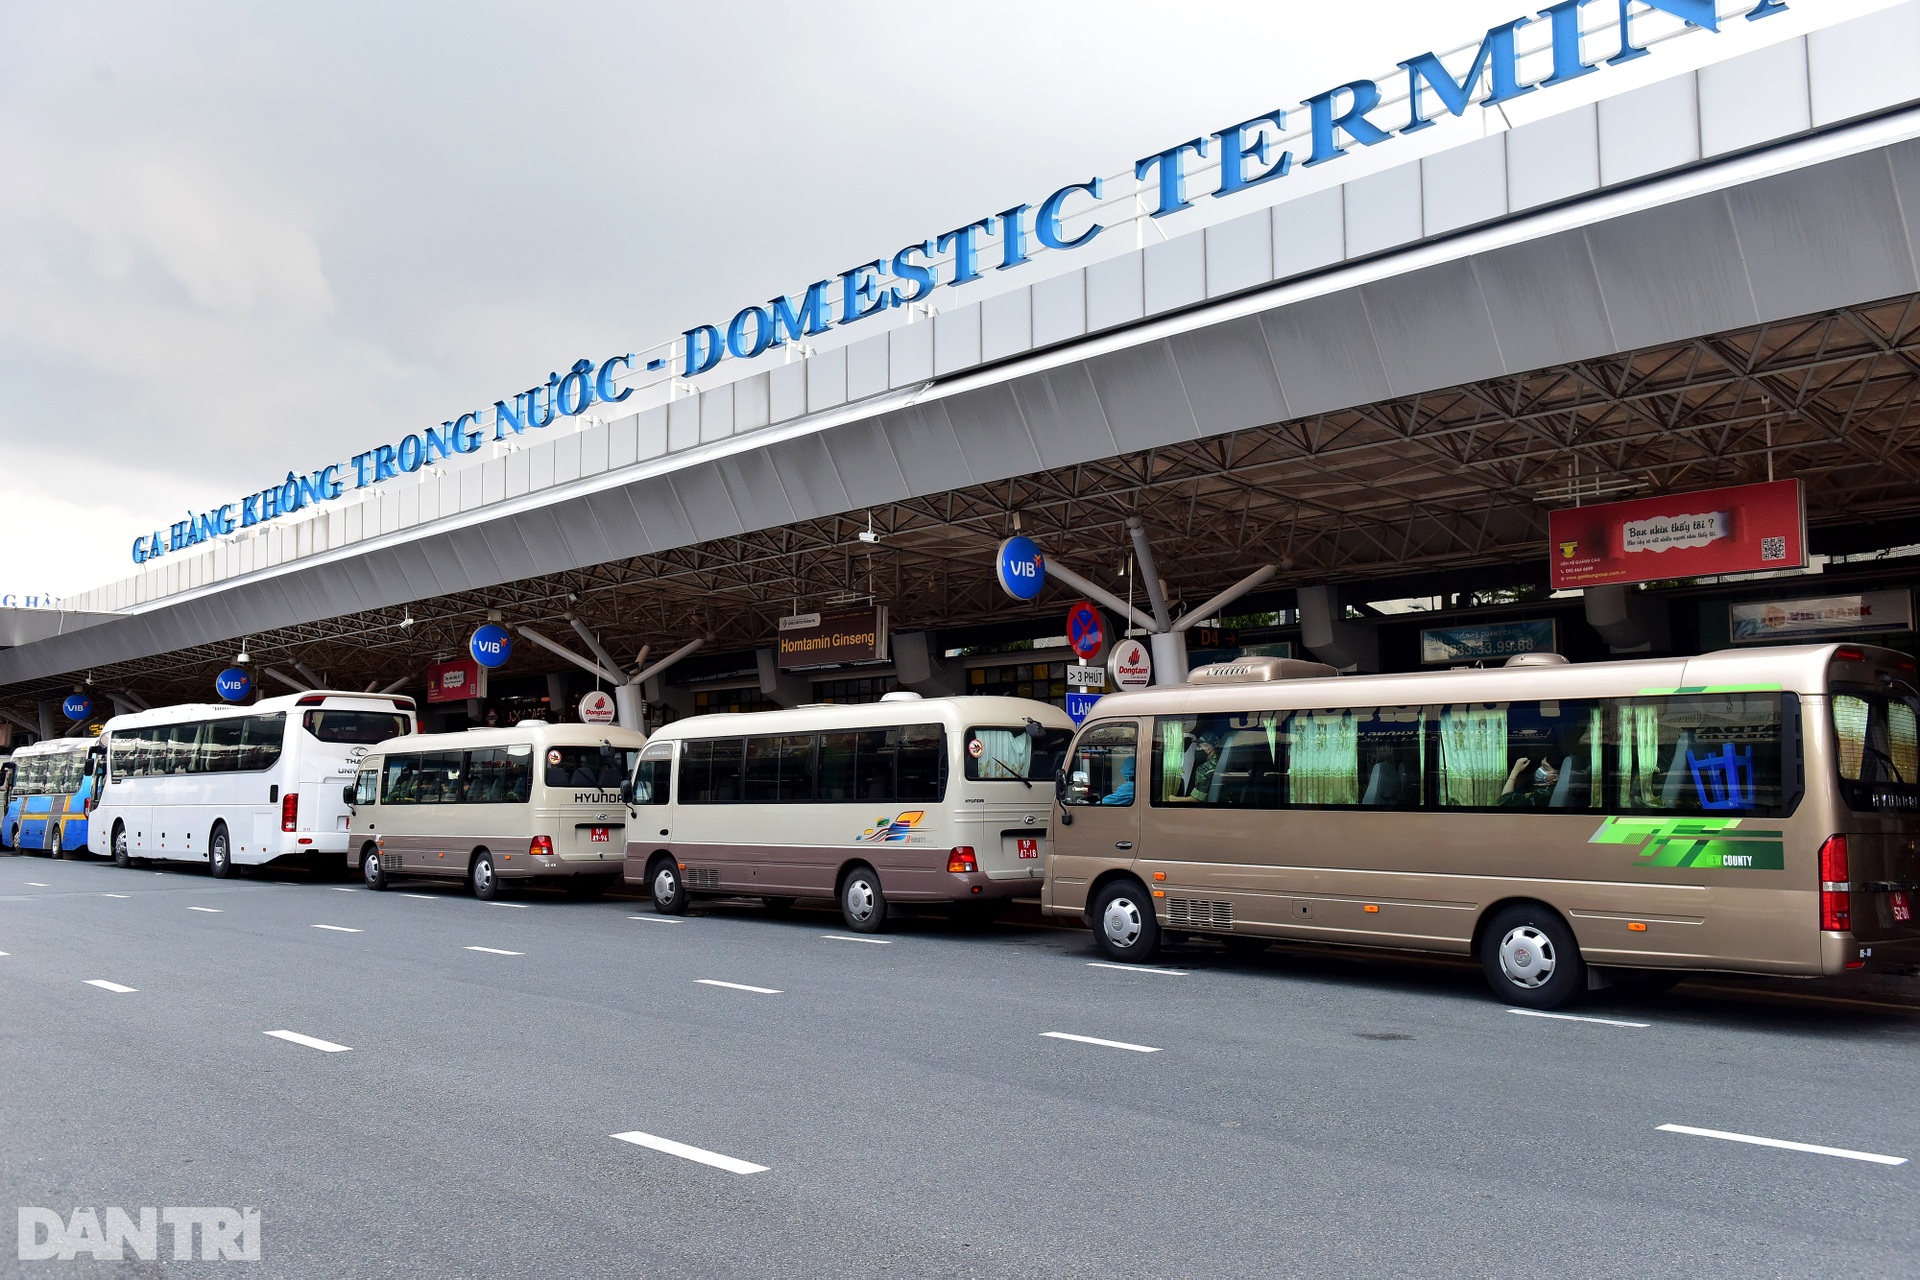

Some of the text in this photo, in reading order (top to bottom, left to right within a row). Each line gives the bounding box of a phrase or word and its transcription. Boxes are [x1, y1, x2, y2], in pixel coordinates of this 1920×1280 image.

[132, 531, 164, 564] GA
[169, 504, 235, 552] HÀNG
[241, 464, 343, 528] KHÔNG
[351, 411, 484, 489] TRONG
[493, 353, 634, 442] NƯỚC
[682, 177, 1104, 379] DOMESTIC
[1135, 0, 1790, 218] TERMIN
[1628, 527, 1647, 539] Bạn
[1649, 525, 1668, 535] nhìn
[1671, 521, 1690, 533] thấy
[1692, 520, 1705, 530] tôi
[1010, 560, 1036, 577] VIB
[781, 632, 875, 653] Homtamin Ginseng
[1201, 629, 1219, 646] D4
[478, 640, 500, 654] VIB
[1077, 671, 1083, 682] 3
[1084, 670, 1103, 683] PHÚT
[1119, 665, 1148, 675] Dongtam
[221, 680, 242, 690] VIB
[67, 704, 84, 712] VIB
[1072, 698, 1092, 715] LÀN
[1706, 854, 1752, 866] NEW COUNTY
